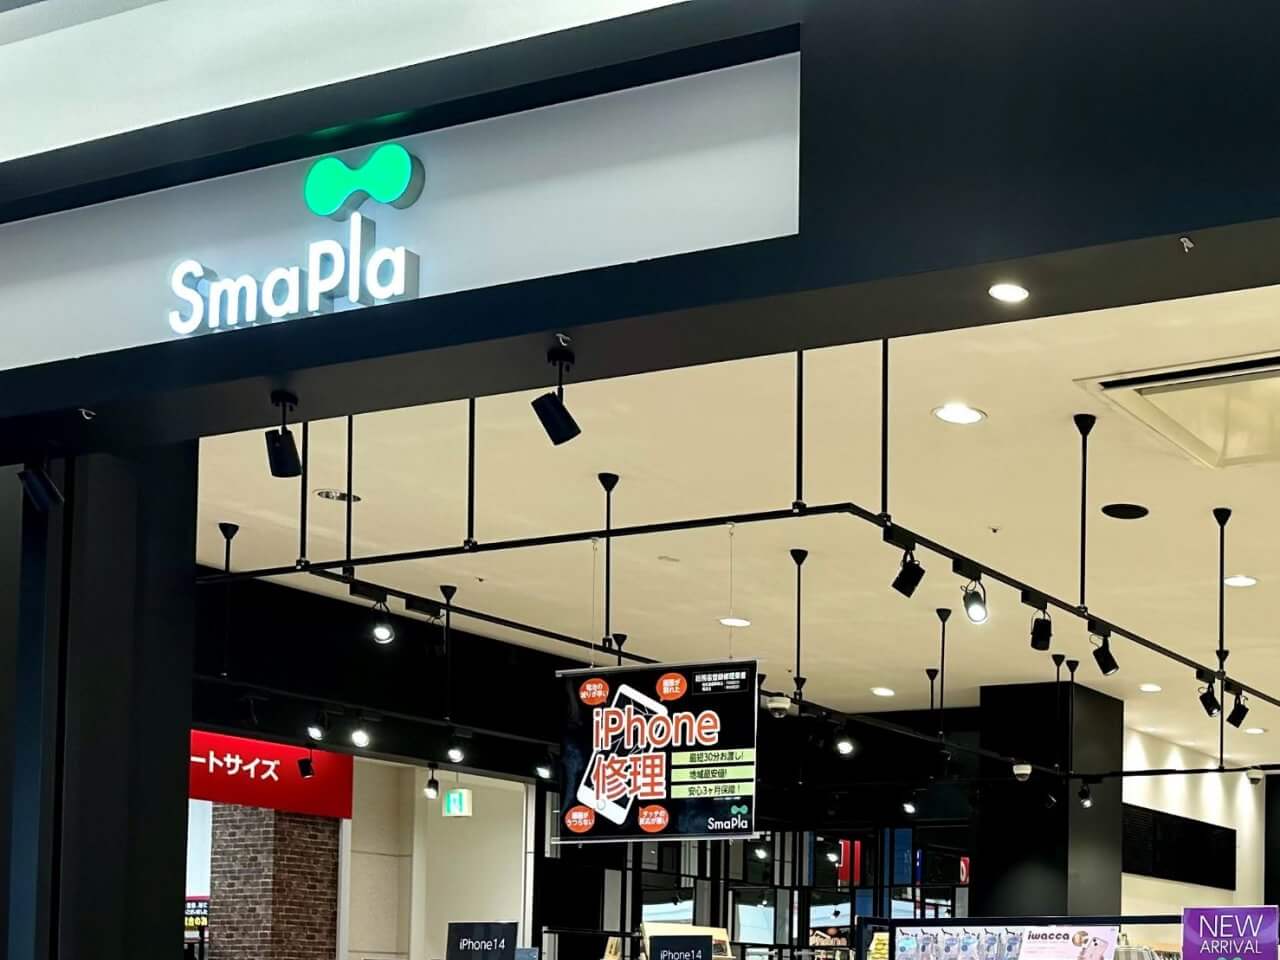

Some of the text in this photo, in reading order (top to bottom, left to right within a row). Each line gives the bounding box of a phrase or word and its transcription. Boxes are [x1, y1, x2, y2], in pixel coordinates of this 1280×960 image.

[169, 211, 407, 334] SmaPla
[593, 704, 721, 750] iPhone
[591, 751, 667, 801] 修理
[707, 814, 749, 830] SmaPla
[1027, 930, 1071, 942] iwacca
[1199, 914, 1264, 938] NEW
[1200, 939, 1262, 954] ARRIVAL
